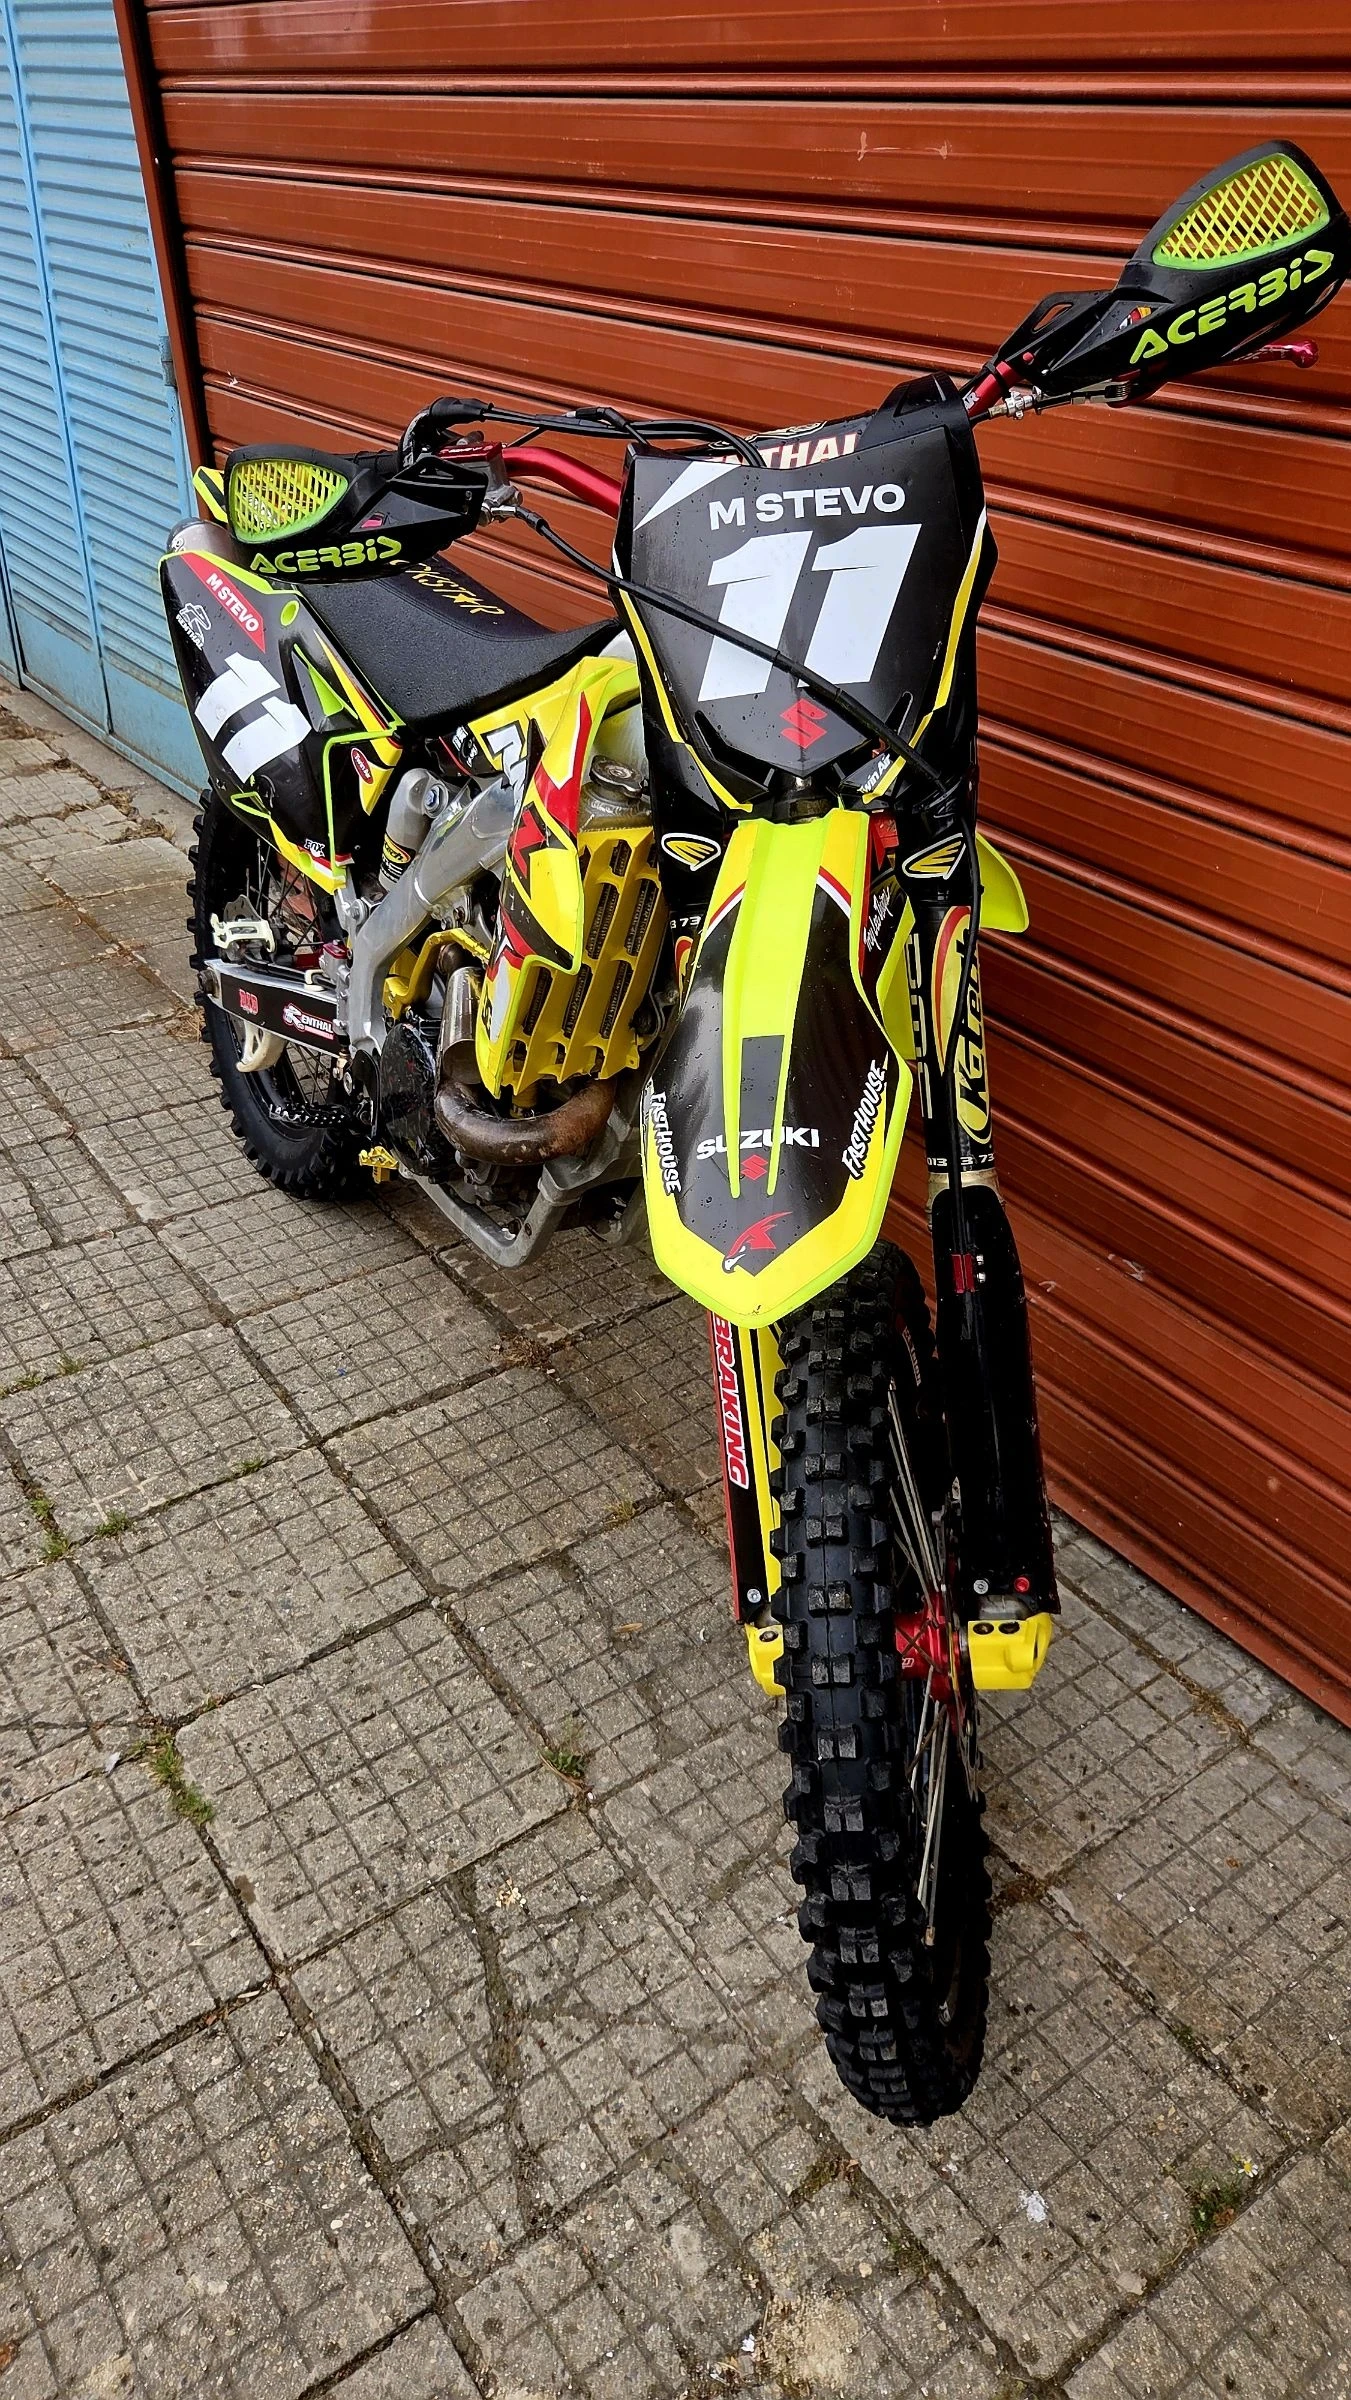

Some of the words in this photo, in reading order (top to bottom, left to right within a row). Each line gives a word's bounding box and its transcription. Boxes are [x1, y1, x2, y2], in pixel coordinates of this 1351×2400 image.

[709, 497, 746, 531] M
[755, 483, 906, 522] STEVO
[206, 573, 223, 591] M
[217, 586, 259, 632] STEVO
[698, 523, 922, 702] 11
[194, 652, 312, 784] 11
[650, 1091, 682, 1193] FASTHOUSE
[842, 1059, 886, 1178] FASTHOUSE
[713, 1313, 749, 1489] BRAKING
